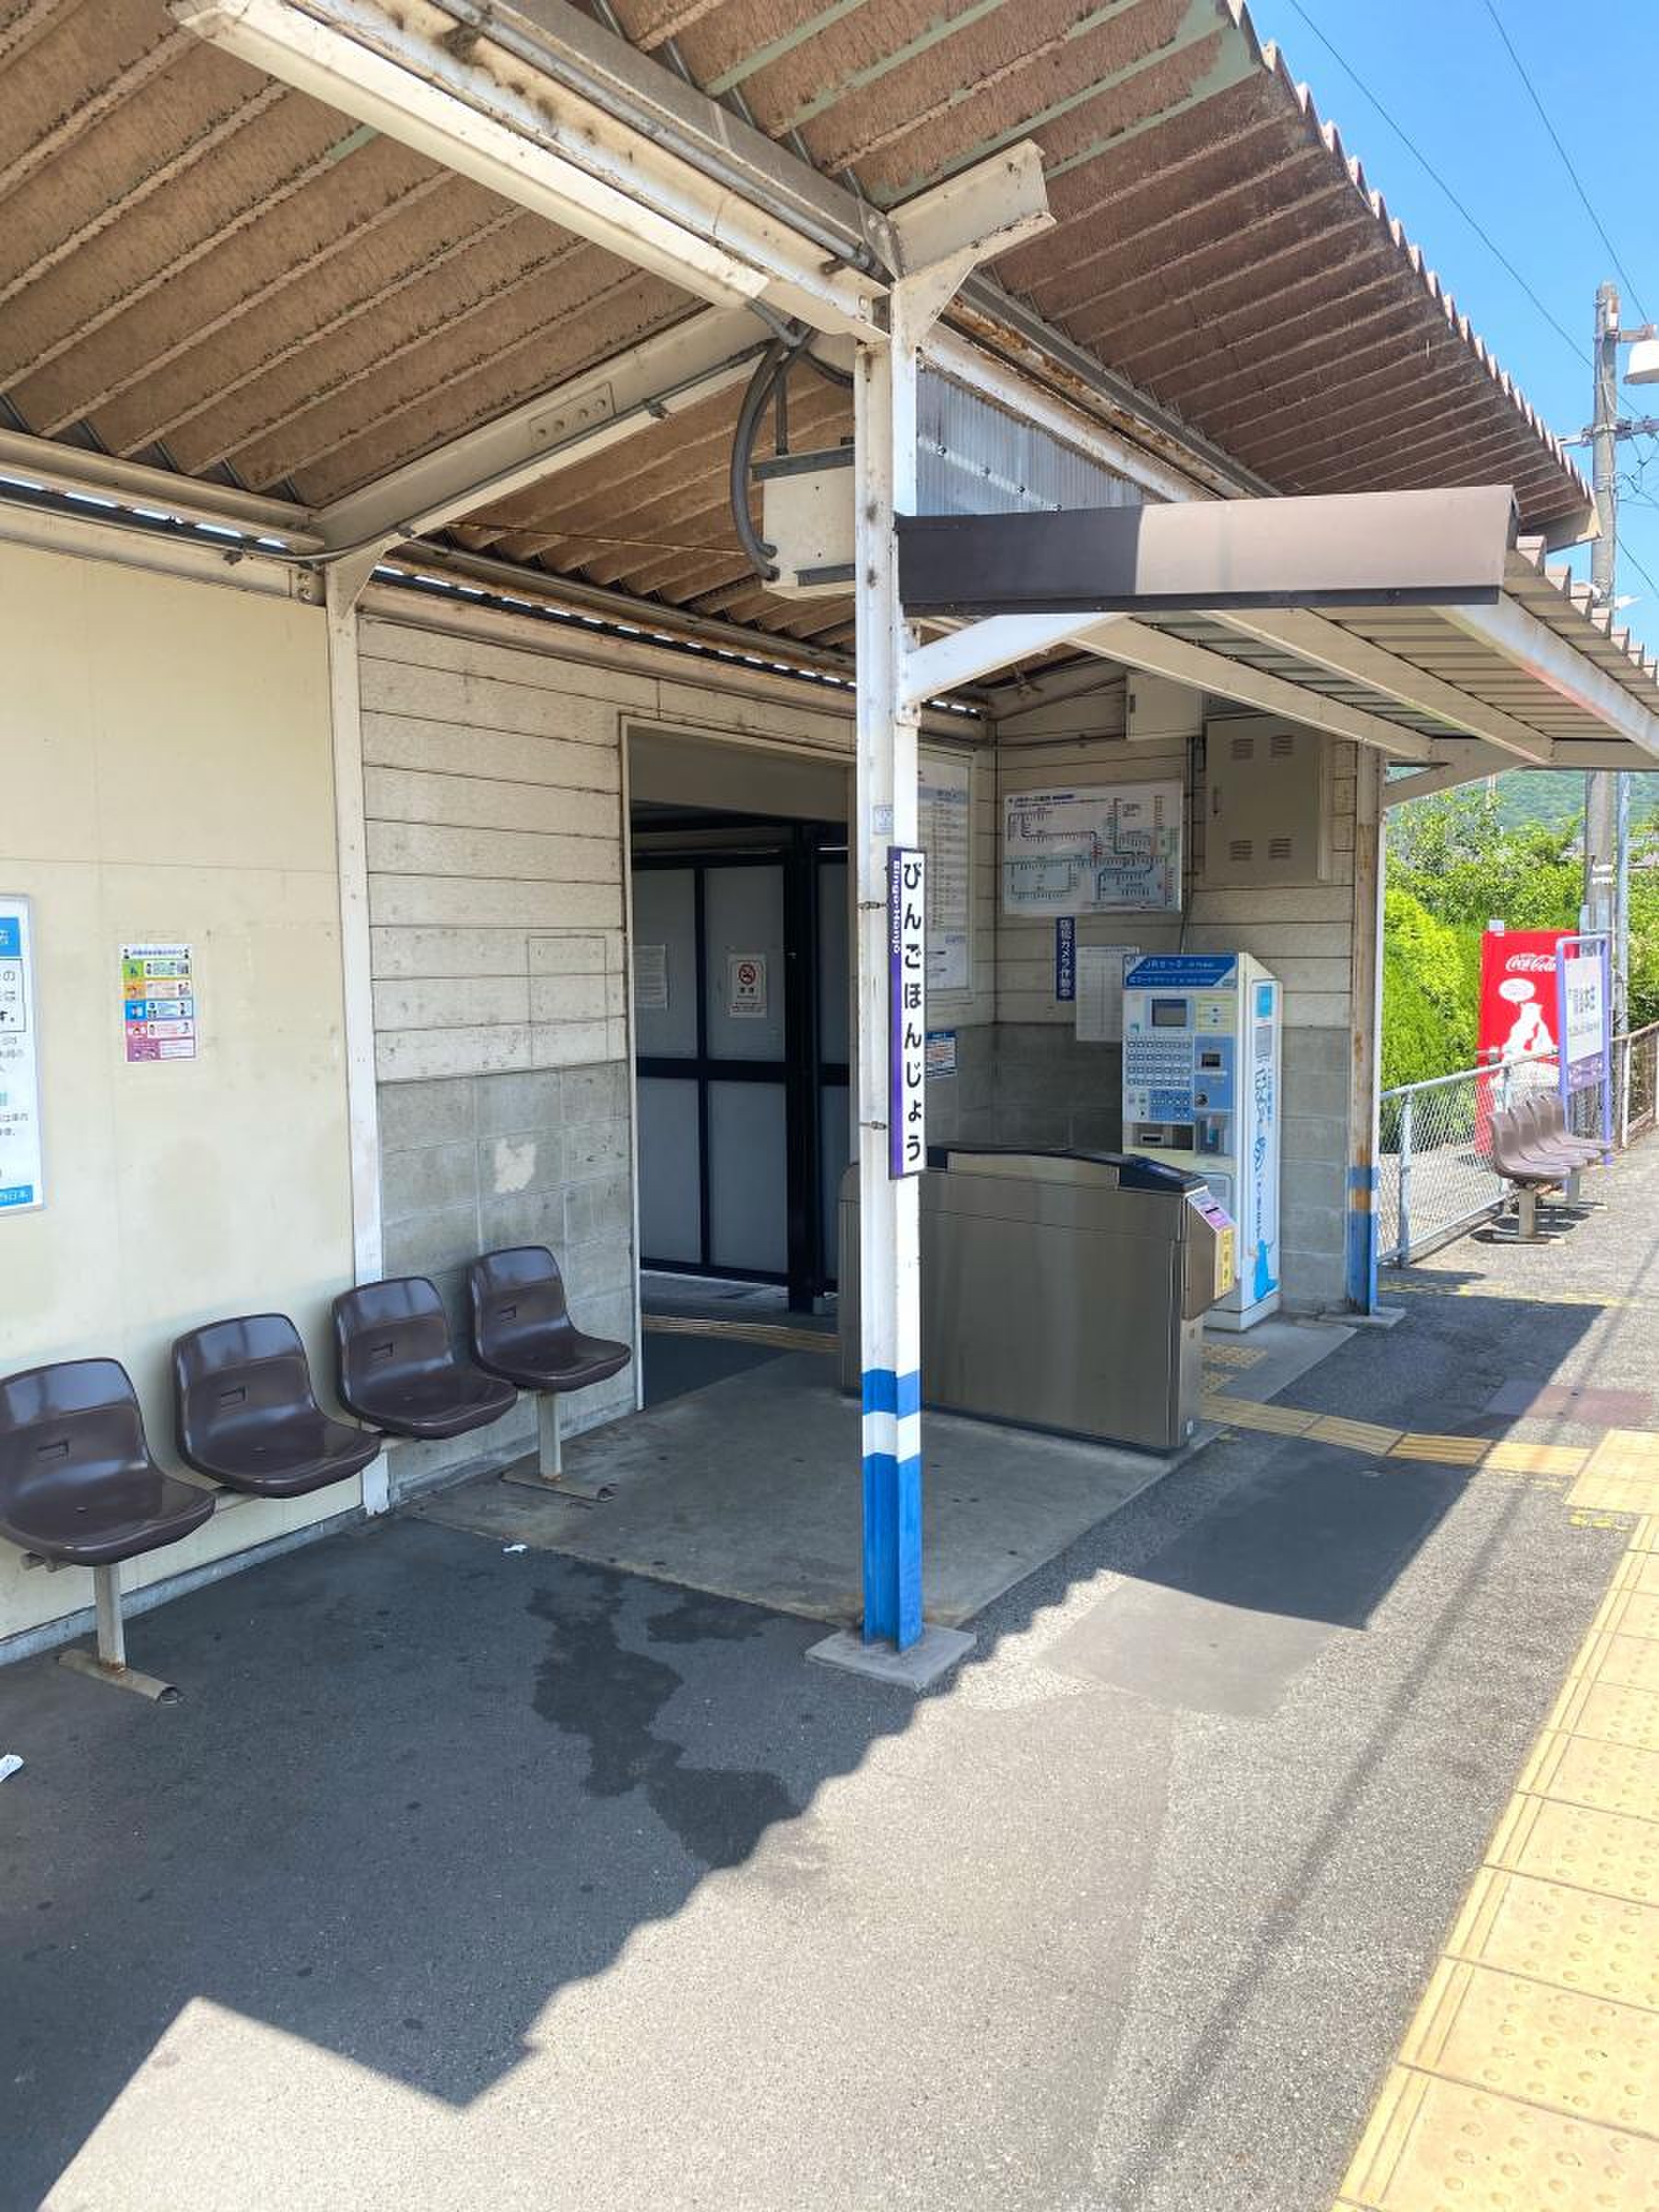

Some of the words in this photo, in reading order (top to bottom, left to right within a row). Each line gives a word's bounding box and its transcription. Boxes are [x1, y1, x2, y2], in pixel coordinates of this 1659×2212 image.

[903, 863, 922, 1161] びんごほんじょう
